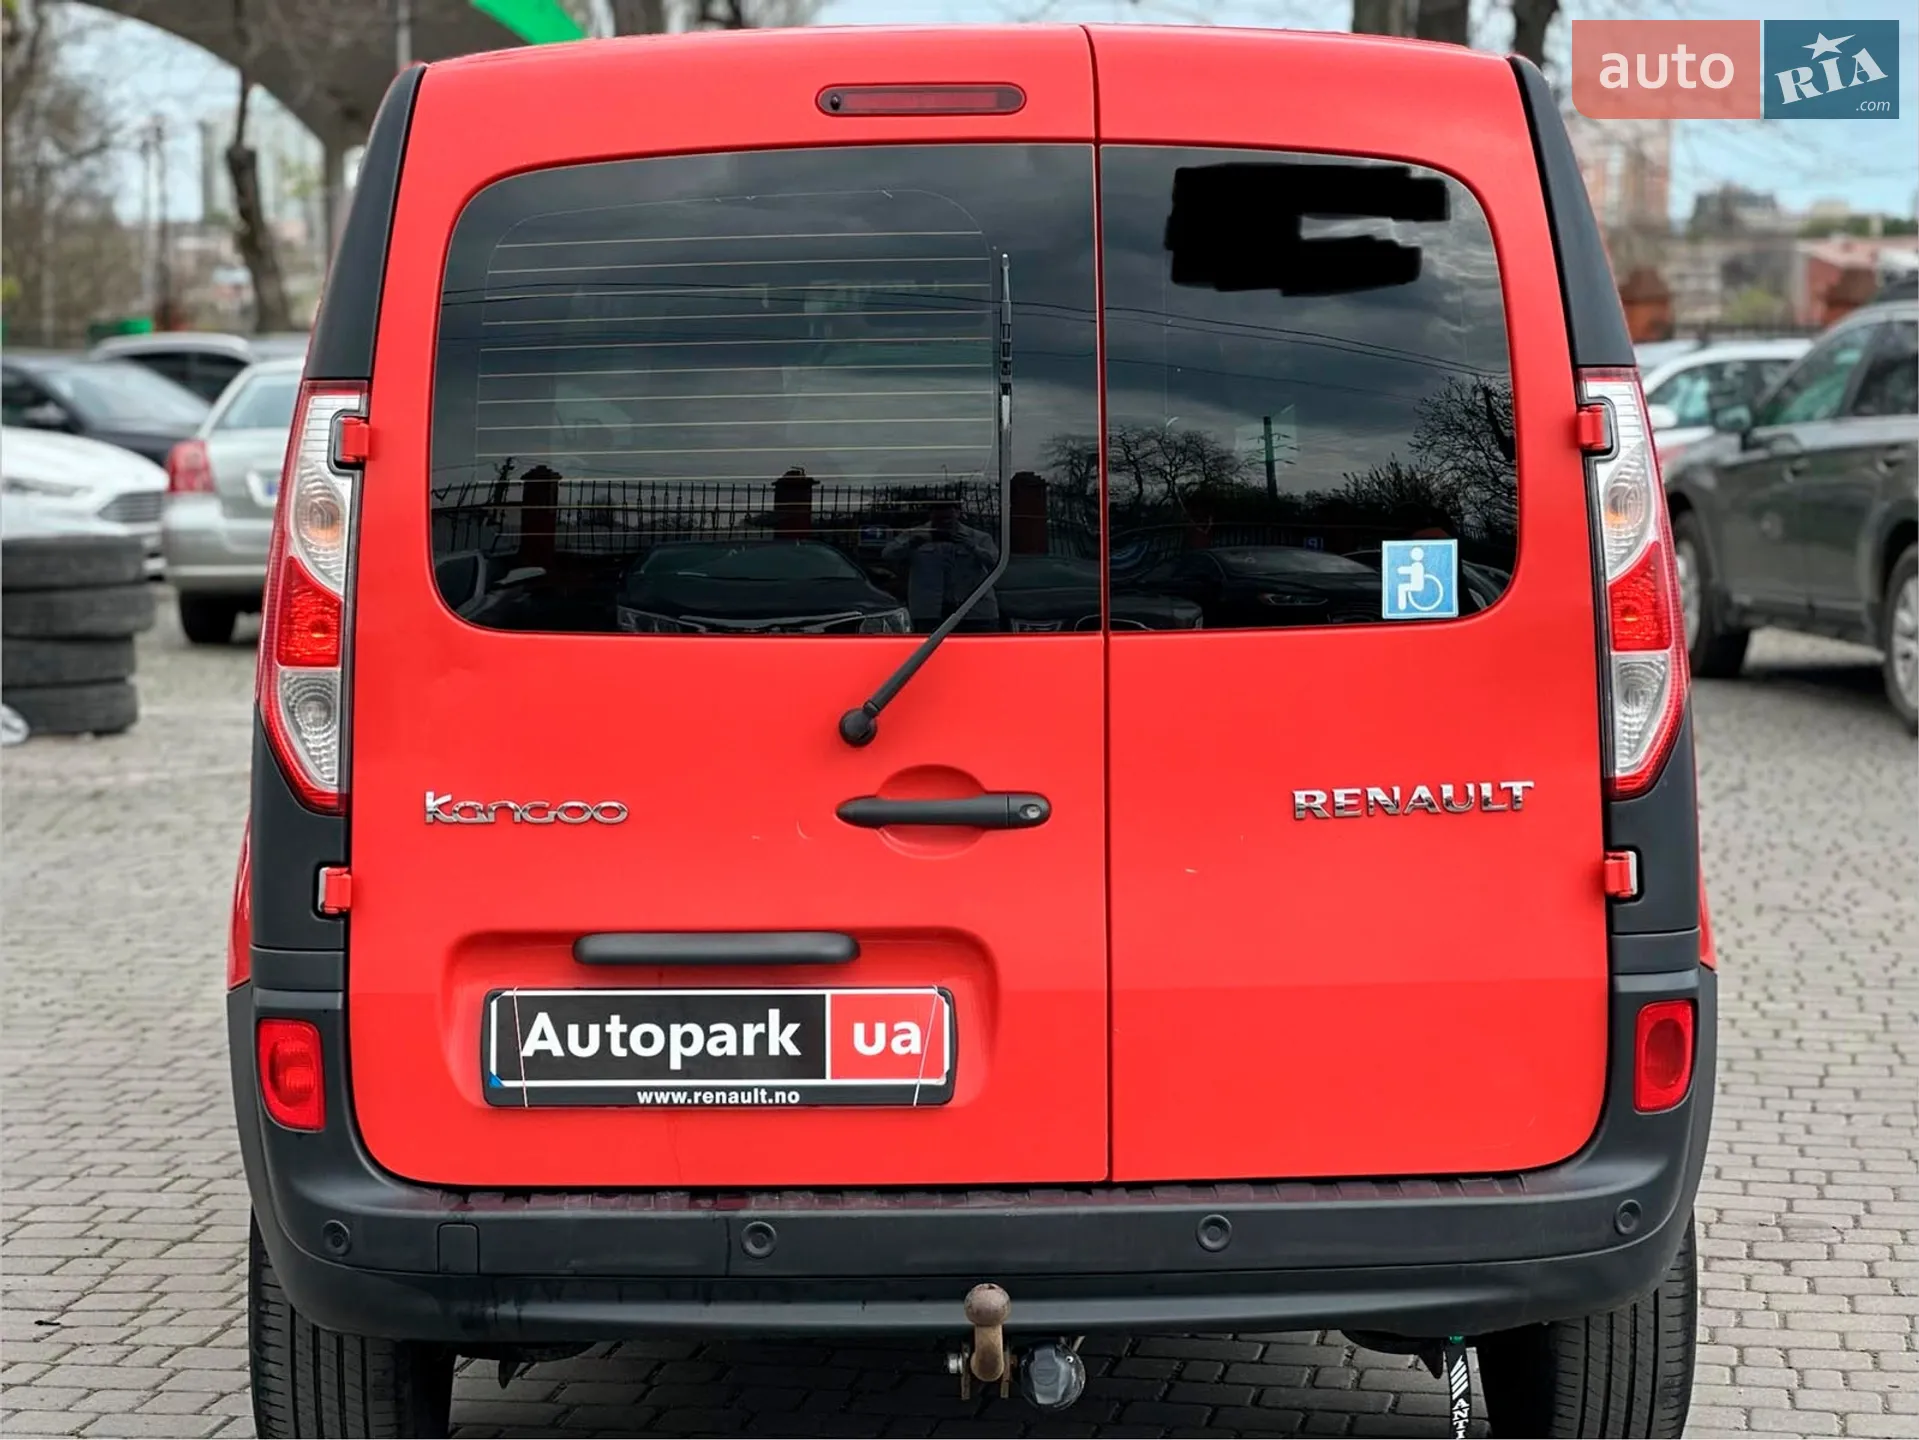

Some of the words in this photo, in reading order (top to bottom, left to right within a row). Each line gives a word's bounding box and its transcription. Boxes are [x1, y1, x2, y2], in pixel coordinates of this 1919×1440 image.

[425, 791, 628, 823] Kangoo
[1292, 781, 1535, 820] RENAULT
[521, 1008, 802, 1069] Autopark
[853, 1020, 922, 1056] ua
[637, 1088, 801, 1105] www.renault.no
